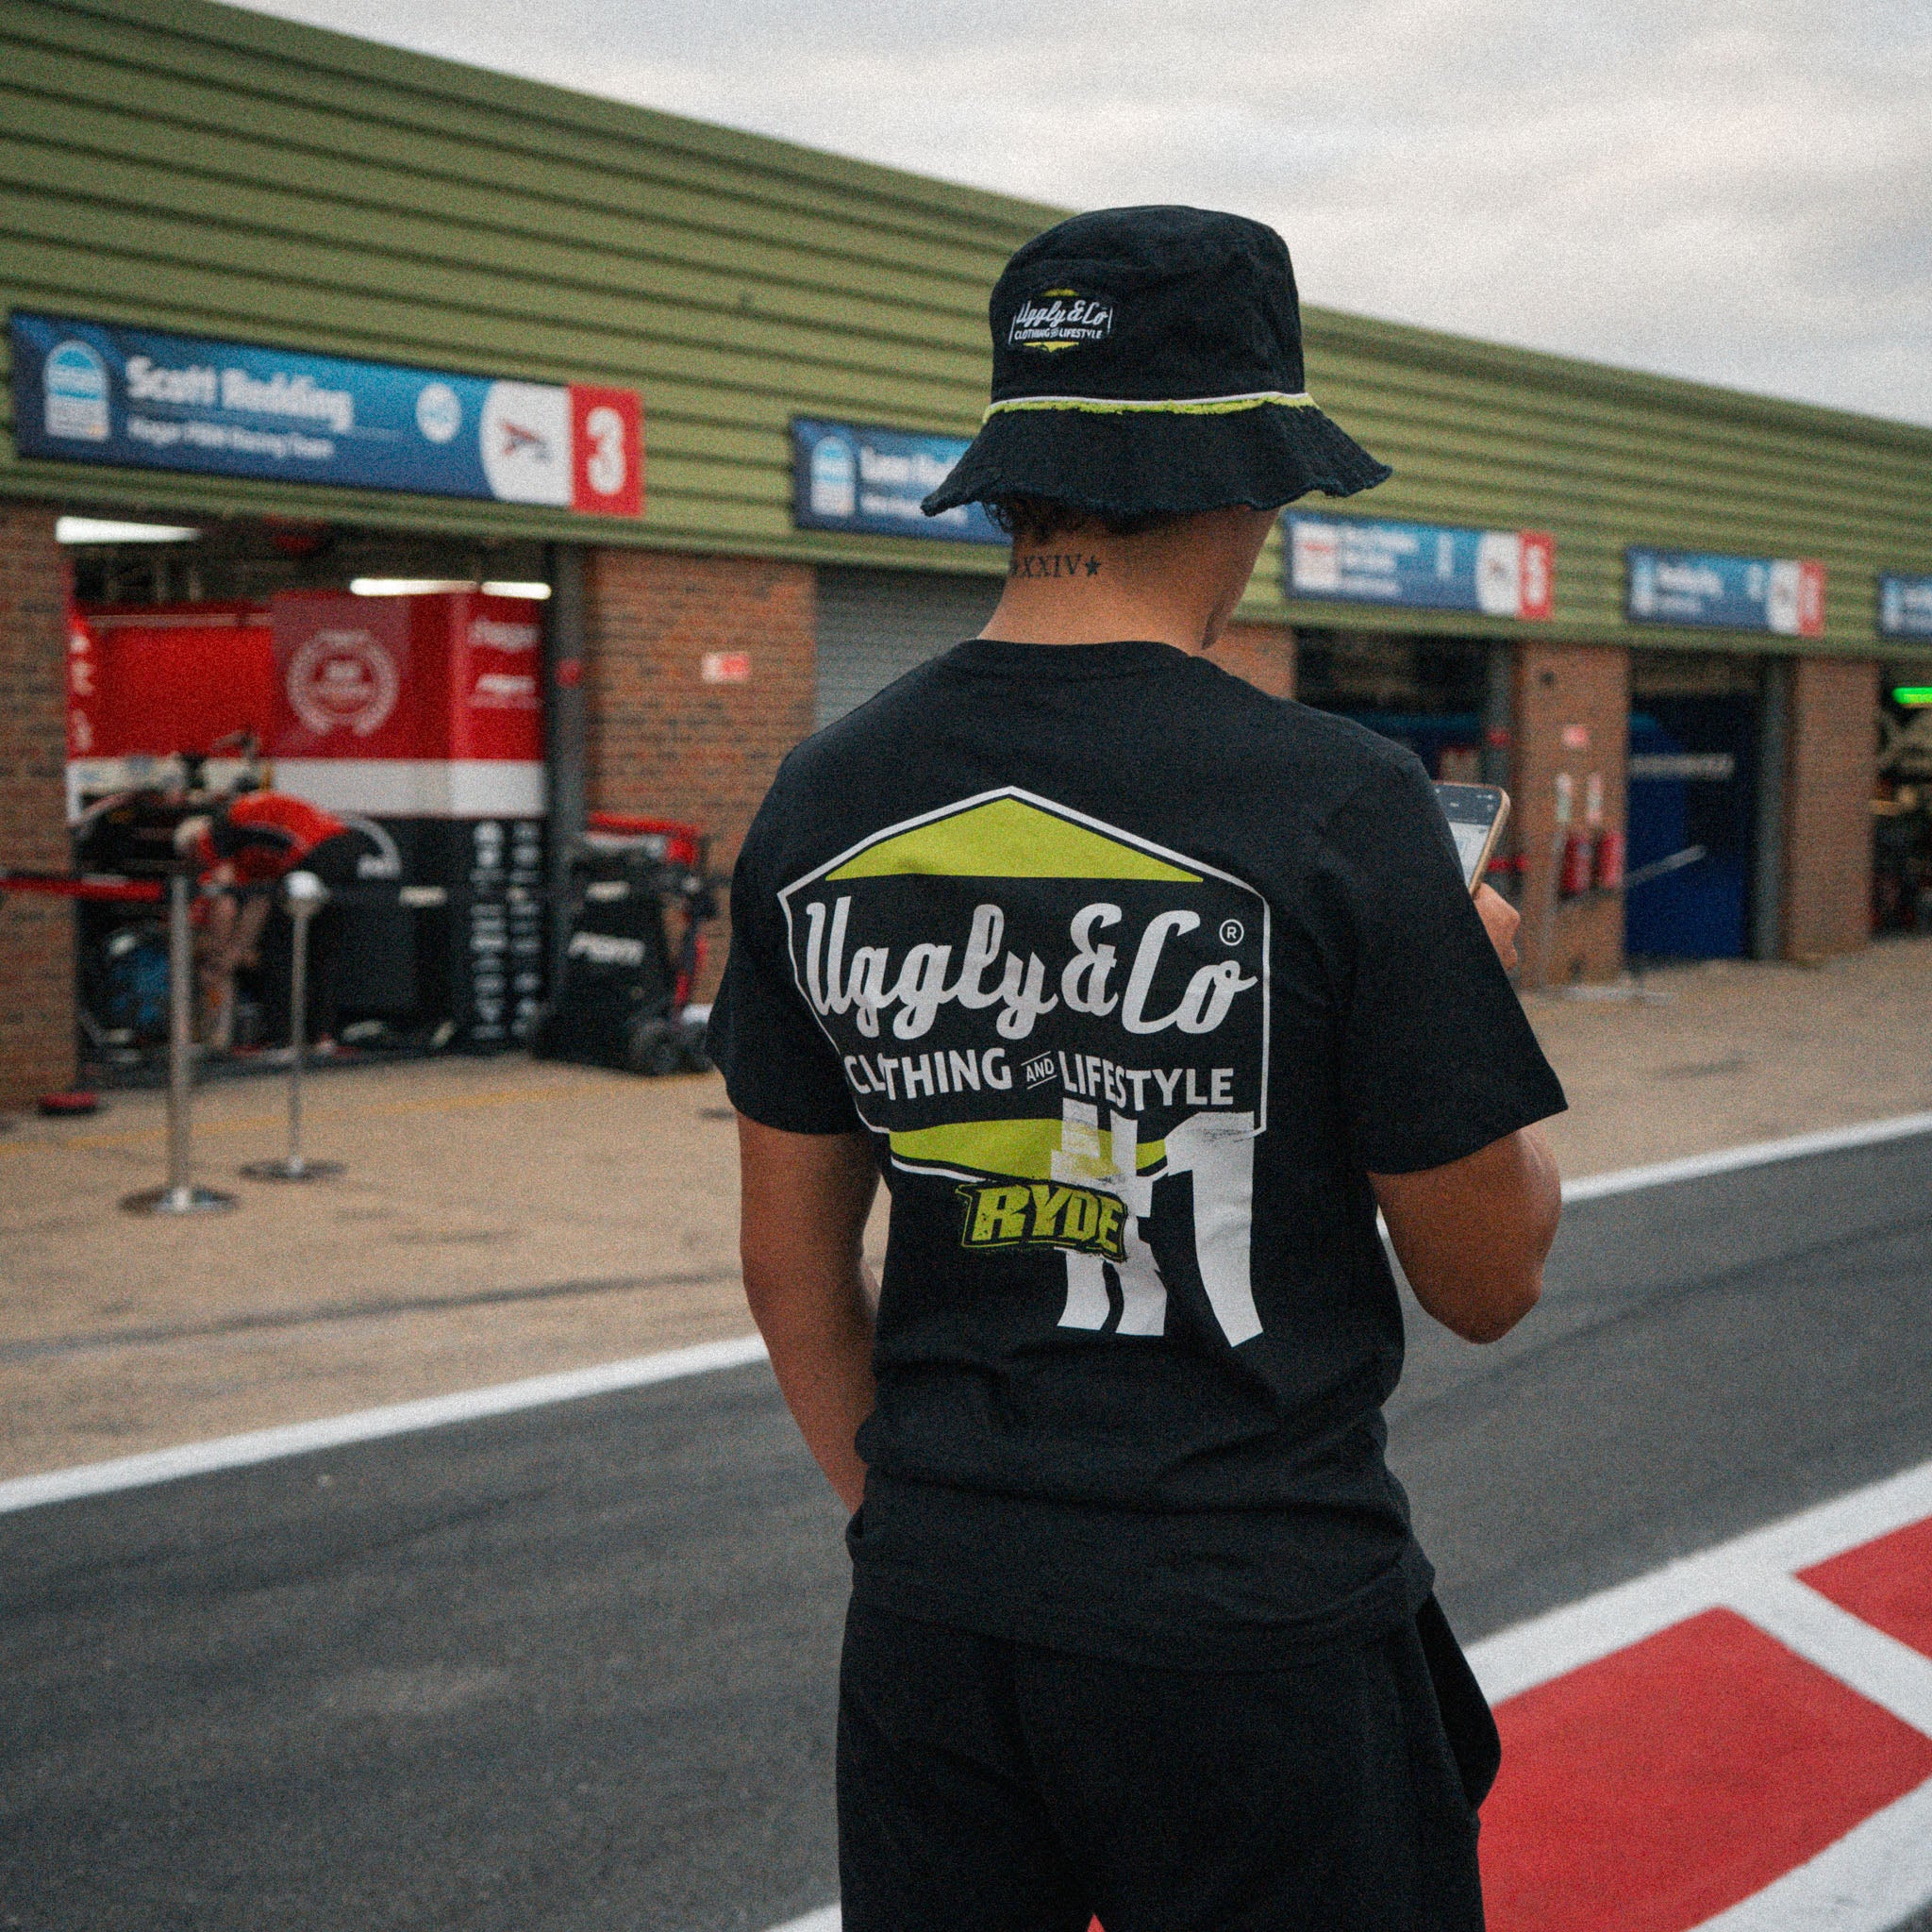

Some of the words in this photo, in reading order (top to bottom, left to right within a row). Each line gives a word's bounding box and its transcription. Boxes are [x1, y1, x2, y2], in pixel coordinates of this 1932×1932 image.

[1058, 327, 1103, 339] LIFESTYLE
[587, 406, 627, 495] 3
[844, 1047, 1012, 1101] CLTHING
[1025, 1058, 1055, 1083] AND
[1058, 1050, 1234, 1111] LIFESTYLE
[972, 1184, 1126, 1254] RYDE
